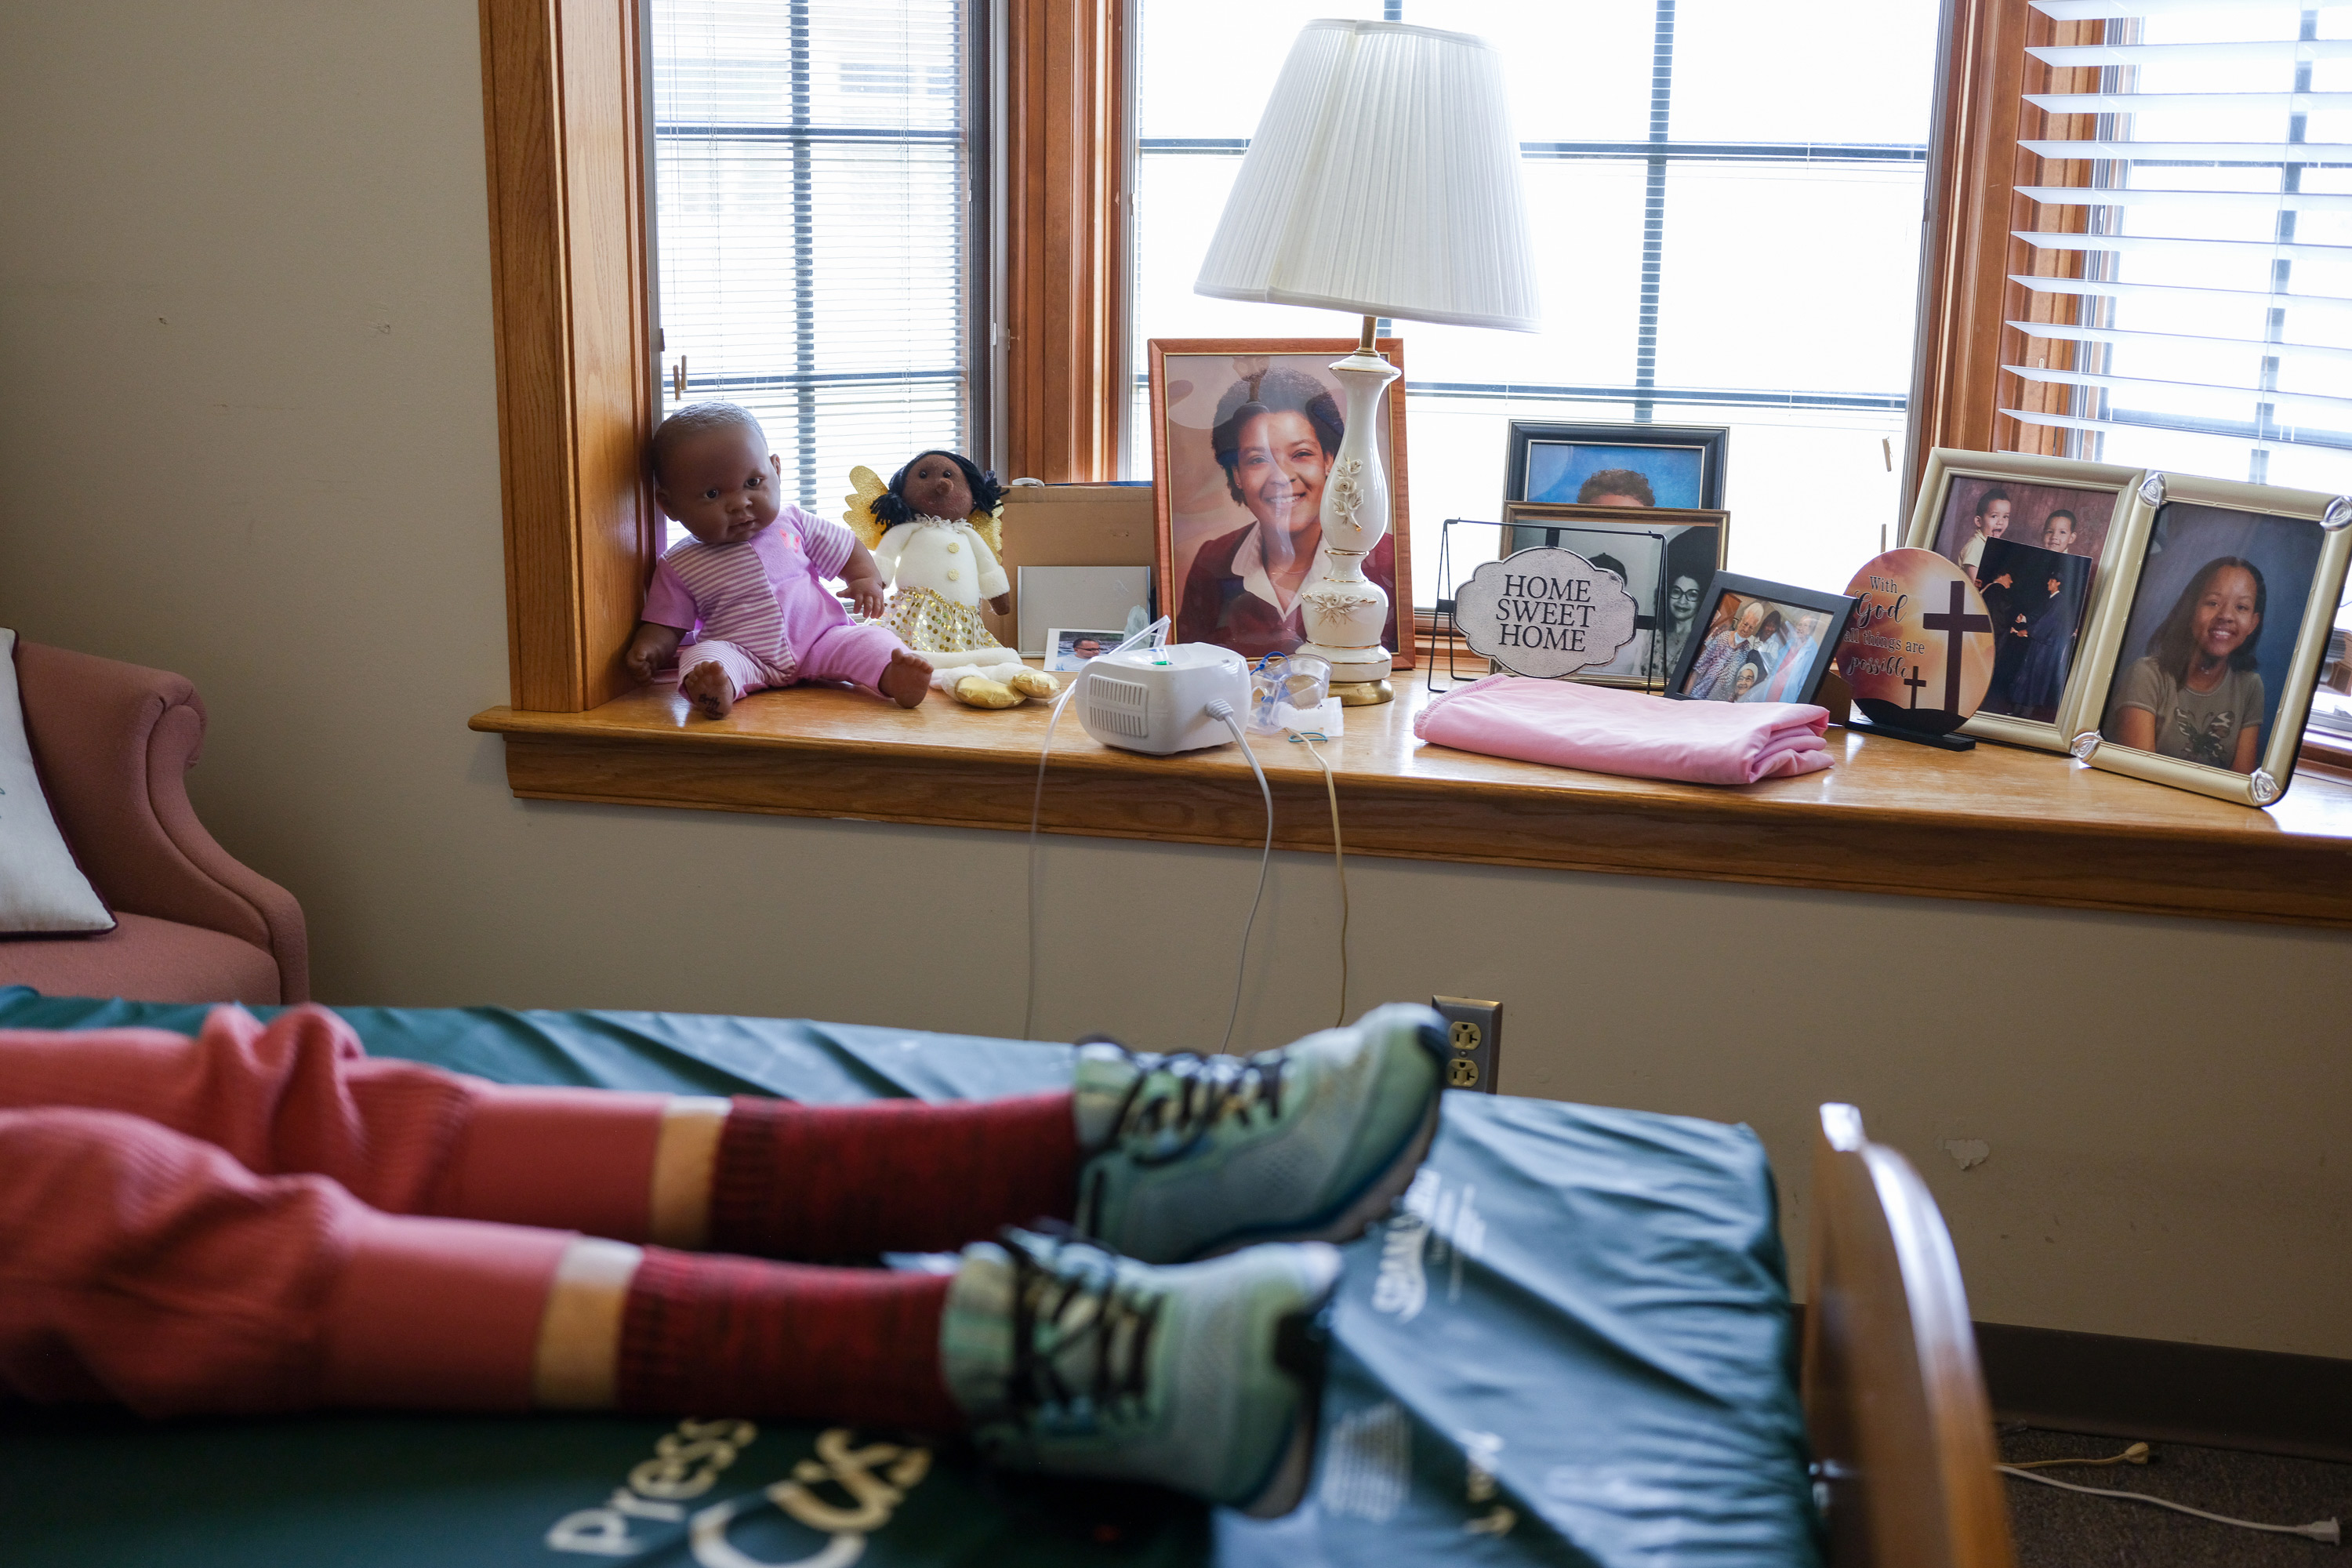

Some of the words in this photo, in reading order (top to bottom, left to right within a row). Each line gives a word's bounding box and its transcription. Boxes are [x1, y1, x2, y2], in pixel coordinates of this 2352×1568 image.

[1503, 574, 1592, 602] HOME
[1869, 575, 1897, 593] With
[1496, 598, 1595, 627] SWEET
[1854, 590, 1908, 628] God
[1498, 623, 1586, 652] HOME
[1843, 628, 1860, 643] all
[1863, 630, 1902, 652] things
[1905, 641, 1926, 655] are
[1846, 655, 1911, 678] possible
